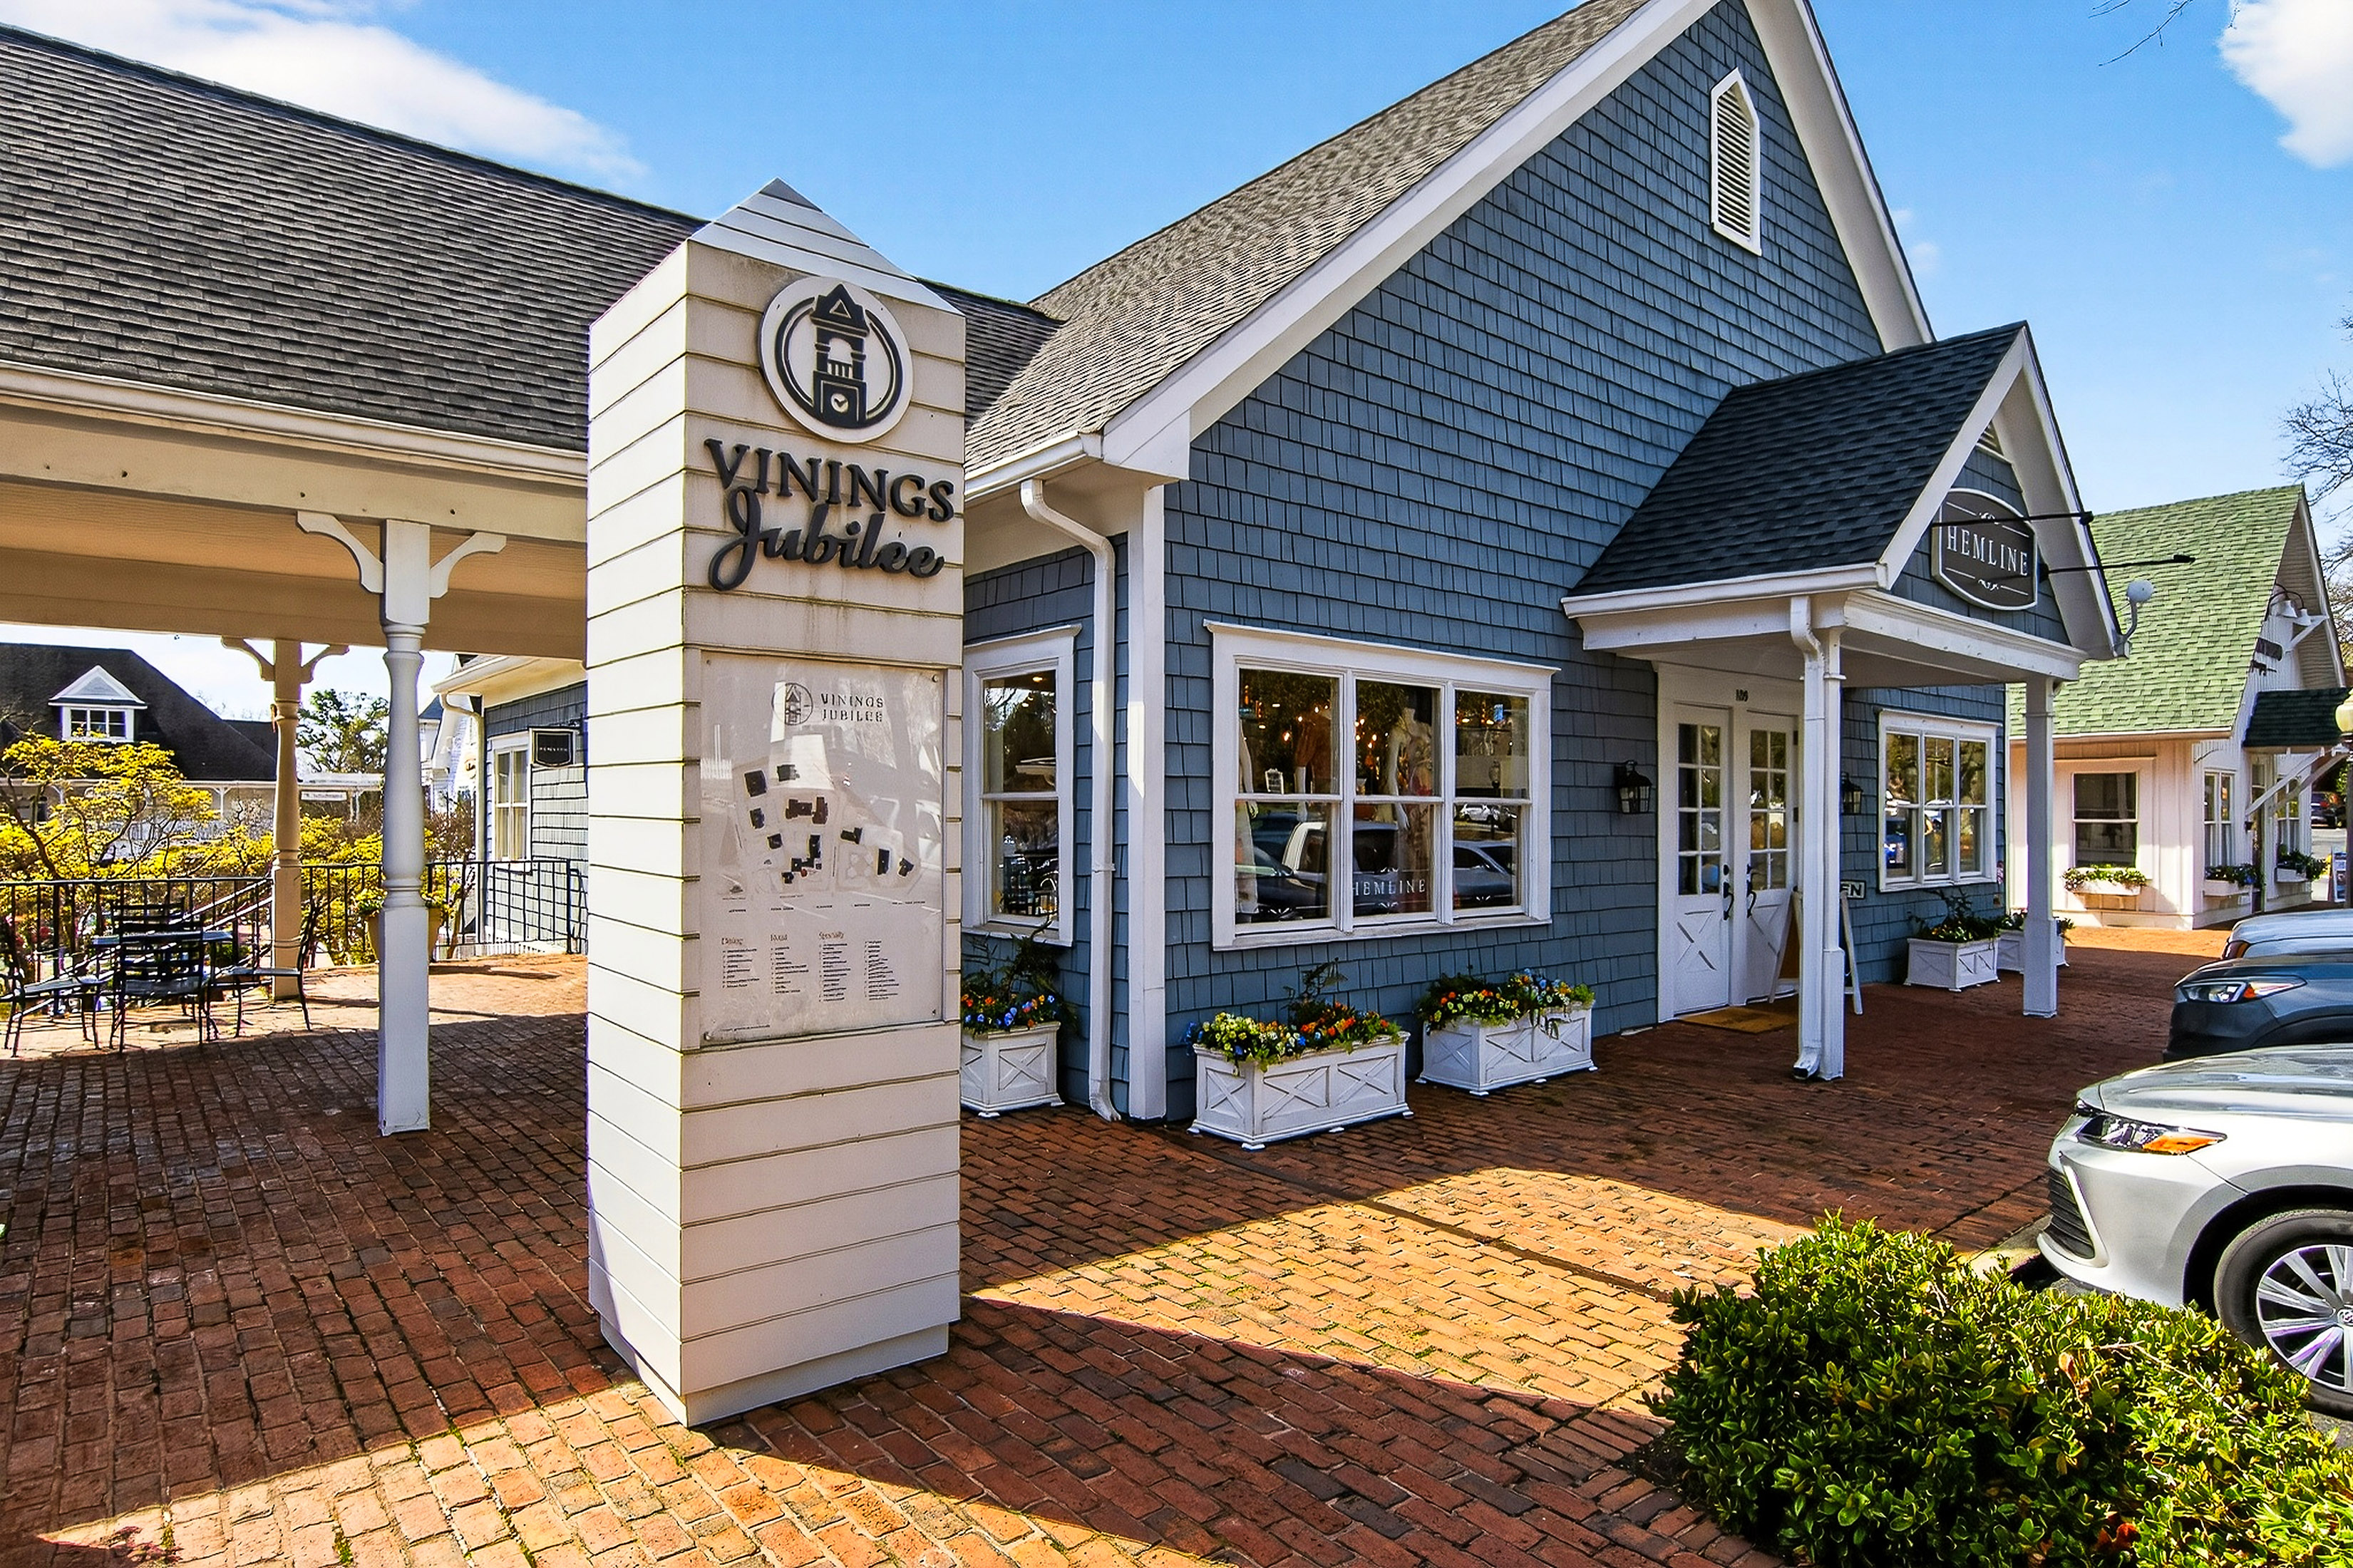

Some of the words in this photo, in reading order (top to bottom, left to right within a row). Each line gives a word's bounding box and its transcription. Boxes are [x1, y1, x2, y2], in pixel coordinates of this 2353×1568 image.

[704, 438, 954, 522] VININGS
[708, 485, 945, 592] Jubilee
[1947, 526, 2028, 576] HEMLINE
[820, 693, 883, 708] VININGS
[822, 708, 882, 722] JUBILEE
